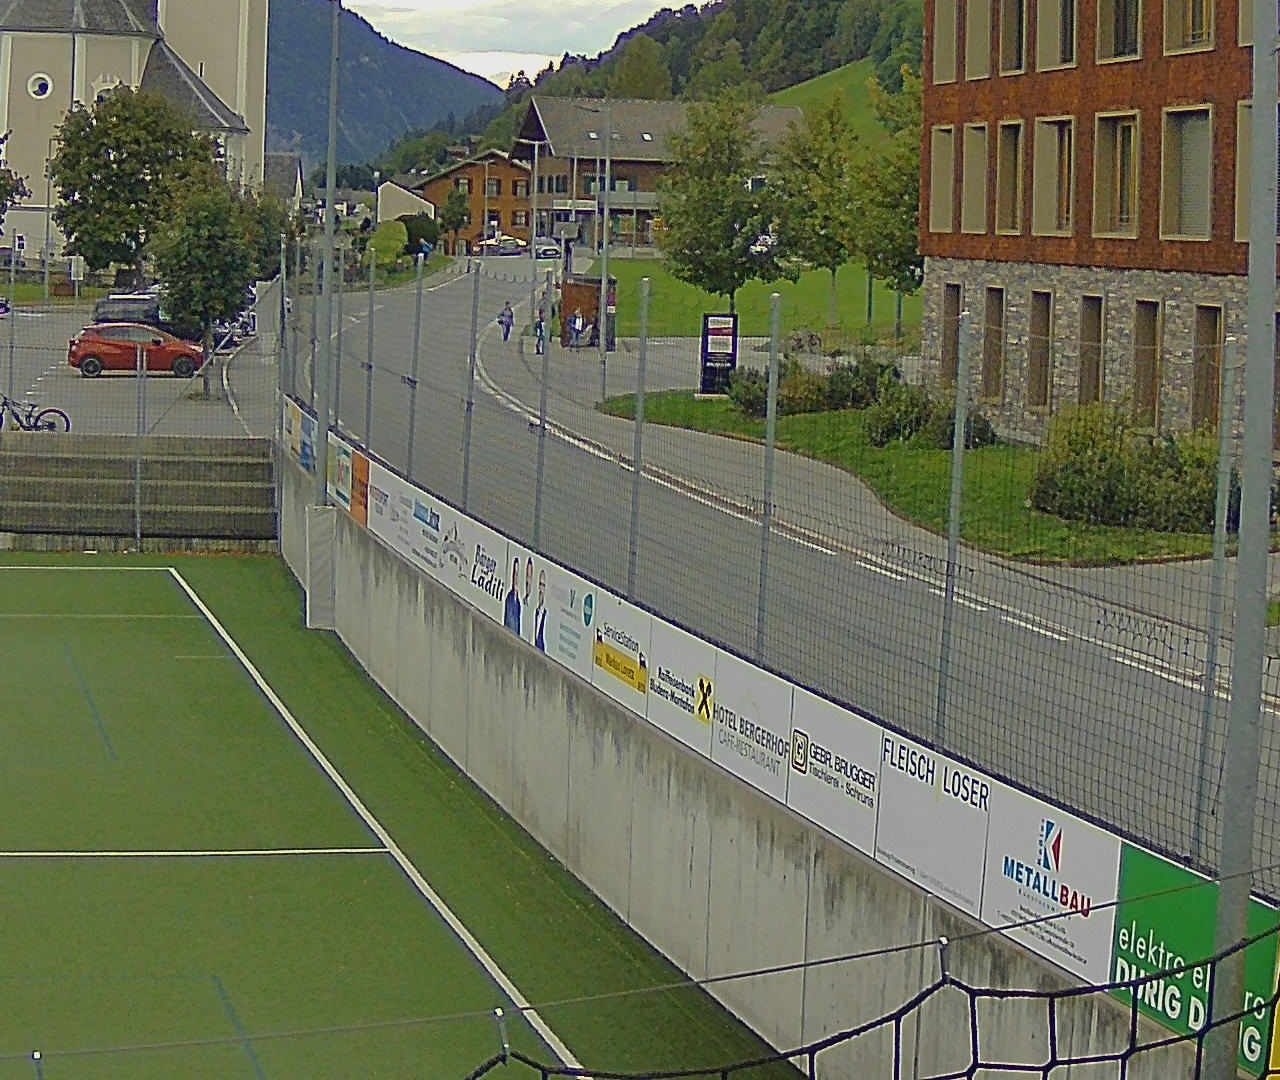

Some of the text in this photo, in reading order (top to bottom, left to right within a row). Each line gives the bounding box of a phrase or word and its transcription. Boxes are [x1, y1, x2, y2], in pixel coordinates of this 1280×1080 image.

[657, 666, 696, 699] Raiffeisenbank
[713, 702, 789, 759] HOTEL BERGERHOF
[808, 761, 840, 789] Tischlerei
[845, 780, 875, 809] Schruns
[809, 742, 876, 793] GEBR. BRUGGER
[883, 737, 990, 812] FLEISCH LOSER
[1003, 855, 1092, 918] METALLBAU
[1118, 920, 1186, 979] elektro
